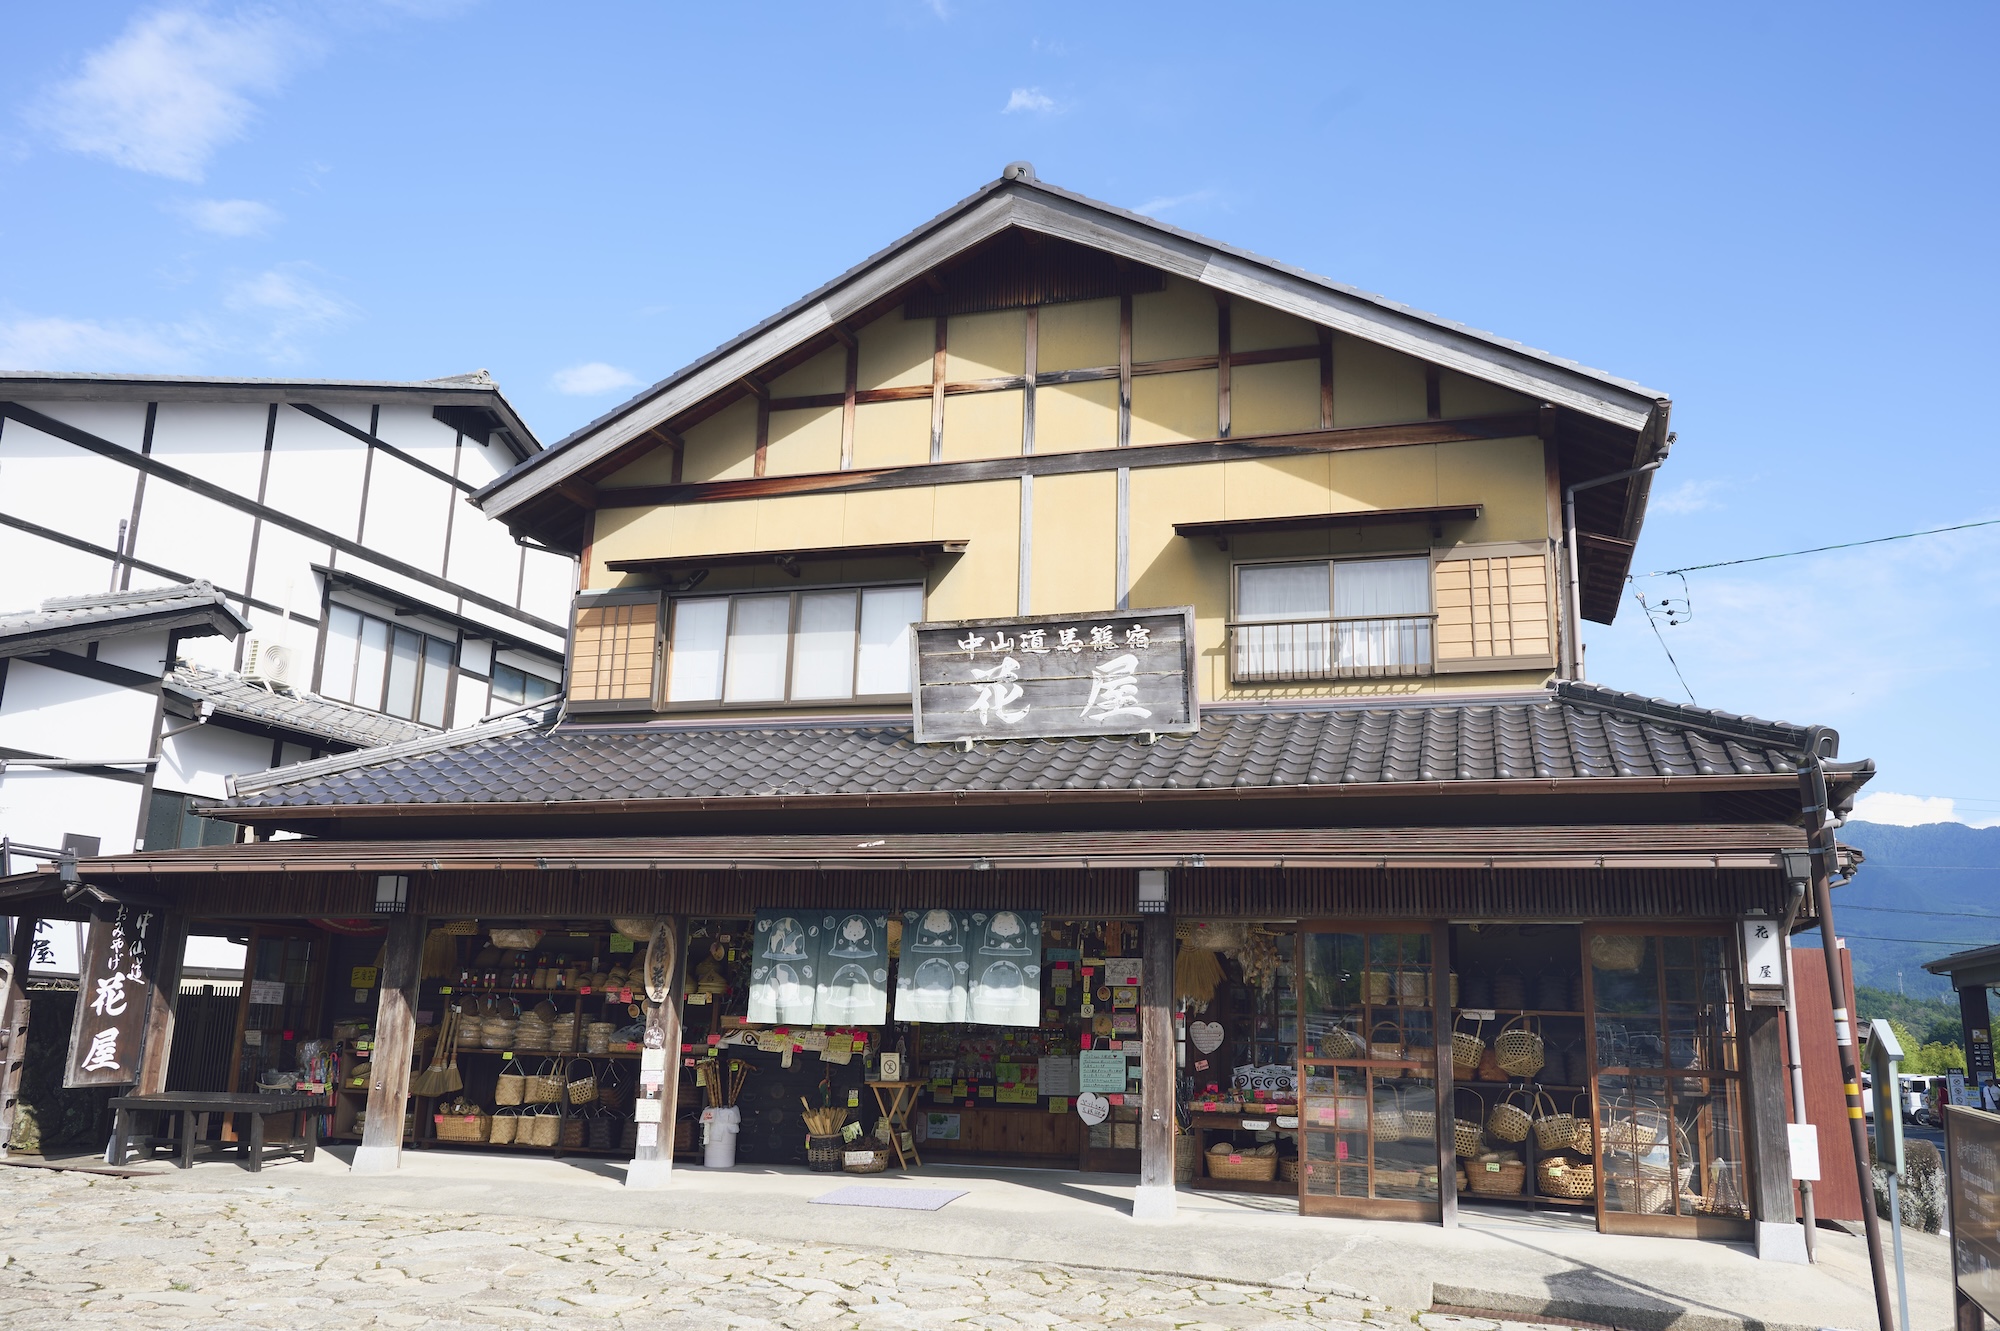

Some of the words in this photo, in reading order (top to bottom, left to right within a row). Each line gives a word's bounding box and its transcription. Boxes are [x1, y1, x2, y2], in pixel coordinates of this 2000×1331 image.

[957, 623, 1151, 660] 中山道馬籠宿
[966, 653, 1153, 726] 花屋
[108, 903, 129, 971] おみやげ
[127, 909, 154, 985] 中仙道
[1754, 924, 1772, 979] 花屋
[81, 972, 128, 1072] 花屋
[1971, 1029, 1980, 1039] P
